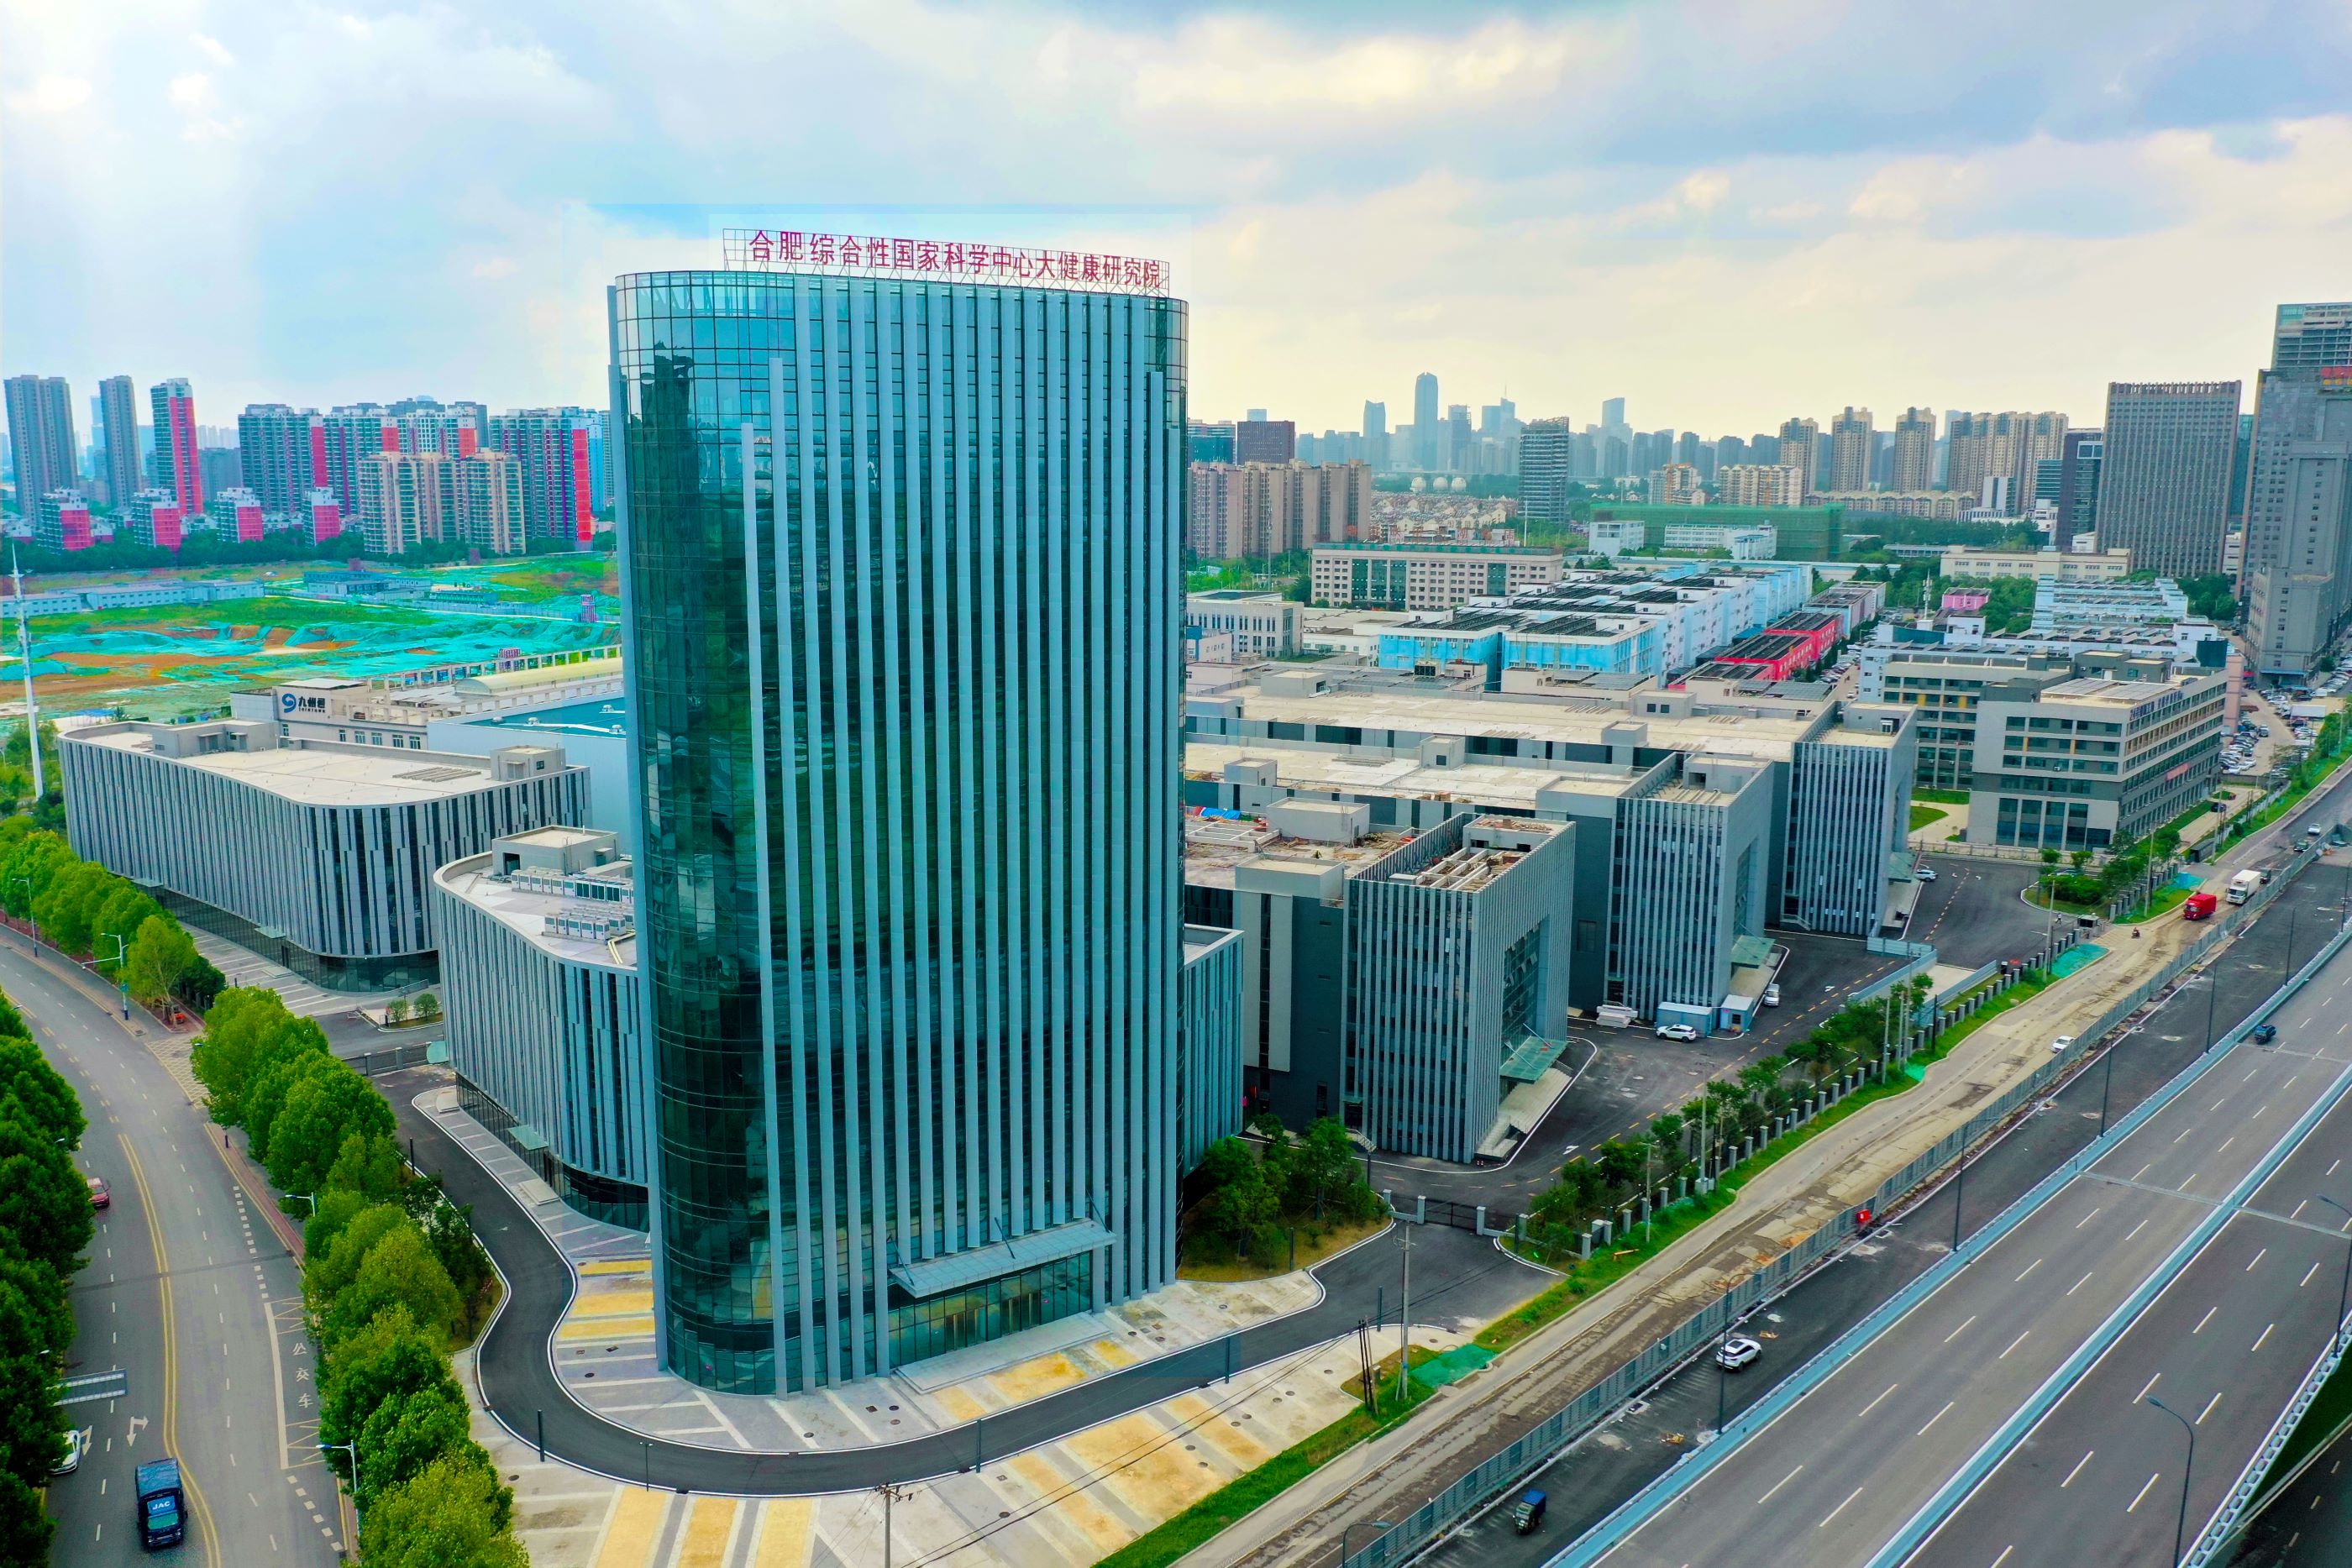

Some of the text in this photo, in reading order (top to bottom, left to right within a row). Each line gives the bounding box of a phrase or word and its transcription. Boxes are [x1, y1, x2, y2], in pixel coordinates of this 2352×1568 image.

[749, 230, 1160, 287] 合肥综合性国家科学中心大健康研究院
[292, 1343, 312, 1408] 公交车
[152, 1501, 171, 1510] JAC
